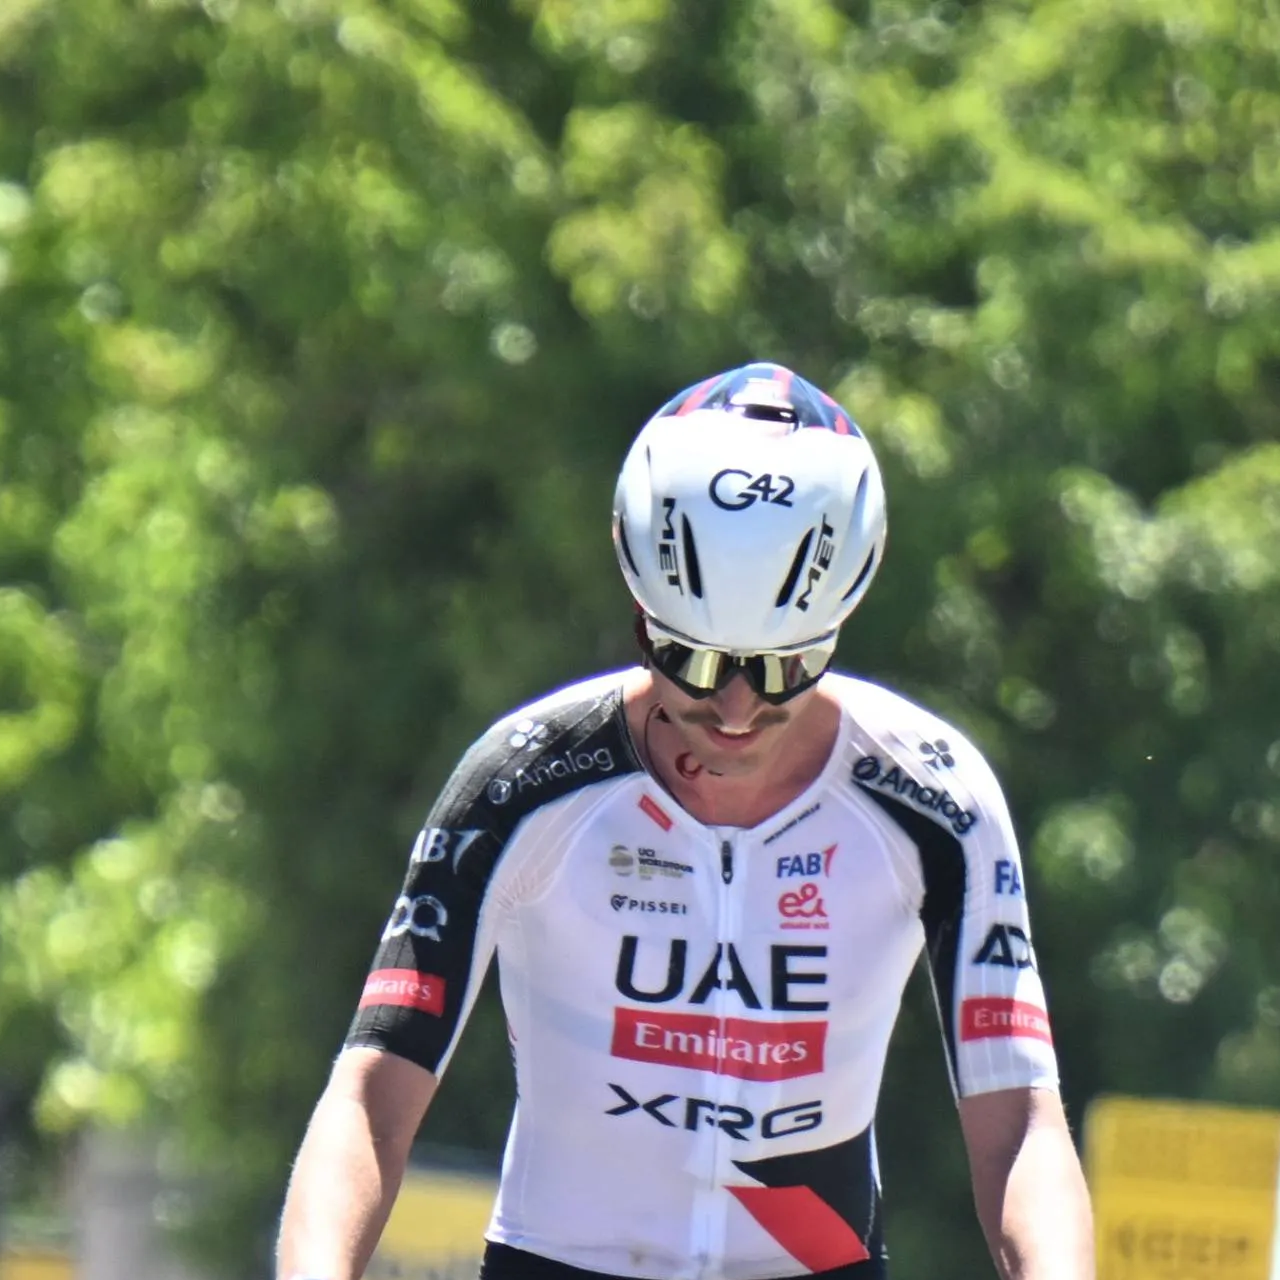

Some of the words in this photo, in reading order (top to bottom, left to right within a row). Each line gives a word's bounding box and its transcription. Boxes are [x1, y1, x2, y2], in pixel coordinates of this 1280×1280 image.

[709, 468, 795, 511] G42
[659, 498, 684, 596] MET
[796, 513, 835, 612] MET
[517, 746, 615, 794] Analog
[878, 771, 977, 835] Analog
[628, 899, 687, 915] PISSEI
[615, 935, 829, 1011] UAE
[635, 1021, 807, 1065] Emirates
[605, 1082, 823, 1142] XRG
